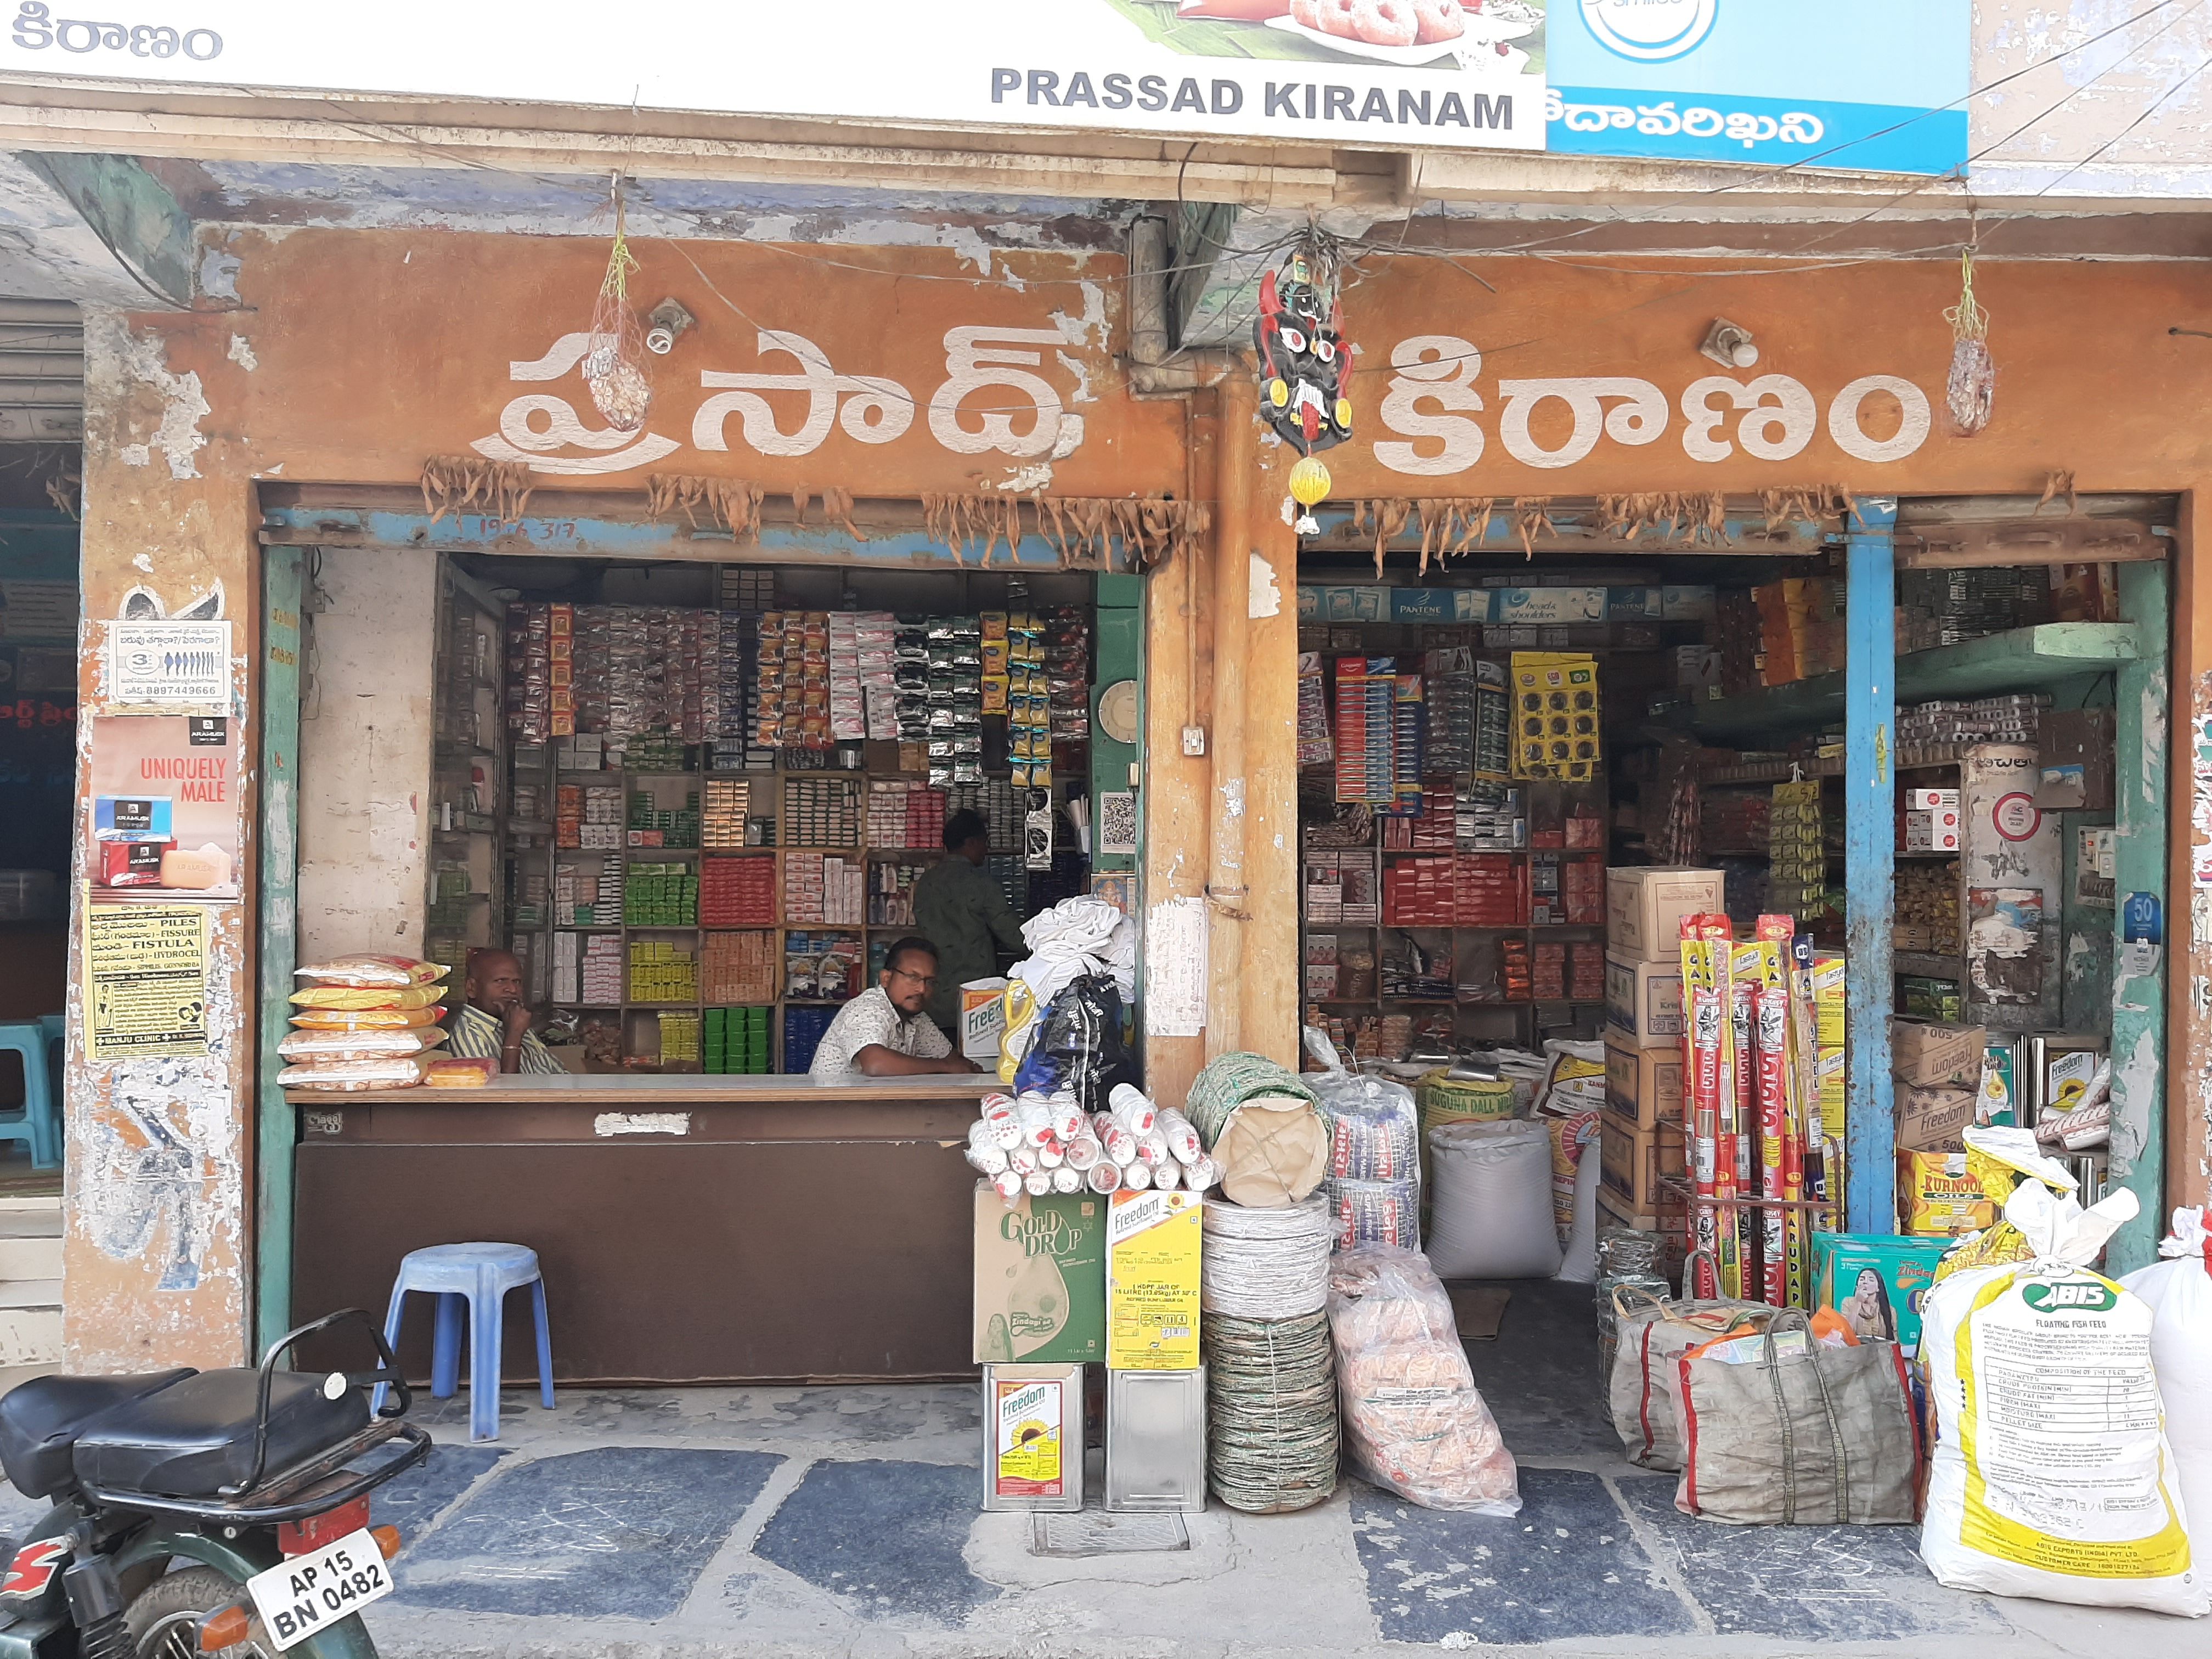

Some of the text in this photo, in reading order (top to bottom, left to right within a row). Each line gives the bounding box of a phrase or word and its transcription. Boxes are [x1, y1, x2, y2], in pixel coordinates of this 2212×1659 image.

[991, 67, 1513, 130] PRASSAD KIRANAM
[1400, 605, 1442, 614] PANTENE
[141, 758, 227, 780] UNIQUELY
[181, 781, 225, 802] MALE
[160, 918, 197, 927] PILES
[132, 939, 194, 949] FISTULA
[2052, 1054, 2083, 1076] Freedom
[1921, 1105, 1966, 1131] Freedom
[1115, 1197, 1160, 1229] Freedom
[1000, 1210, 1062, 1245] GOLD
[1023, 1229, 1082, 1259] DROP
[2034, 1285, 2106, 1308] ABIS
[2036, 1319, 2070, 1328] FLOATING
[1003, 1386, 1045, 1417] Freedom
[289, 1550, 354, 1598] AP 15
[273, 1564, 385, 1640] BN 0482
